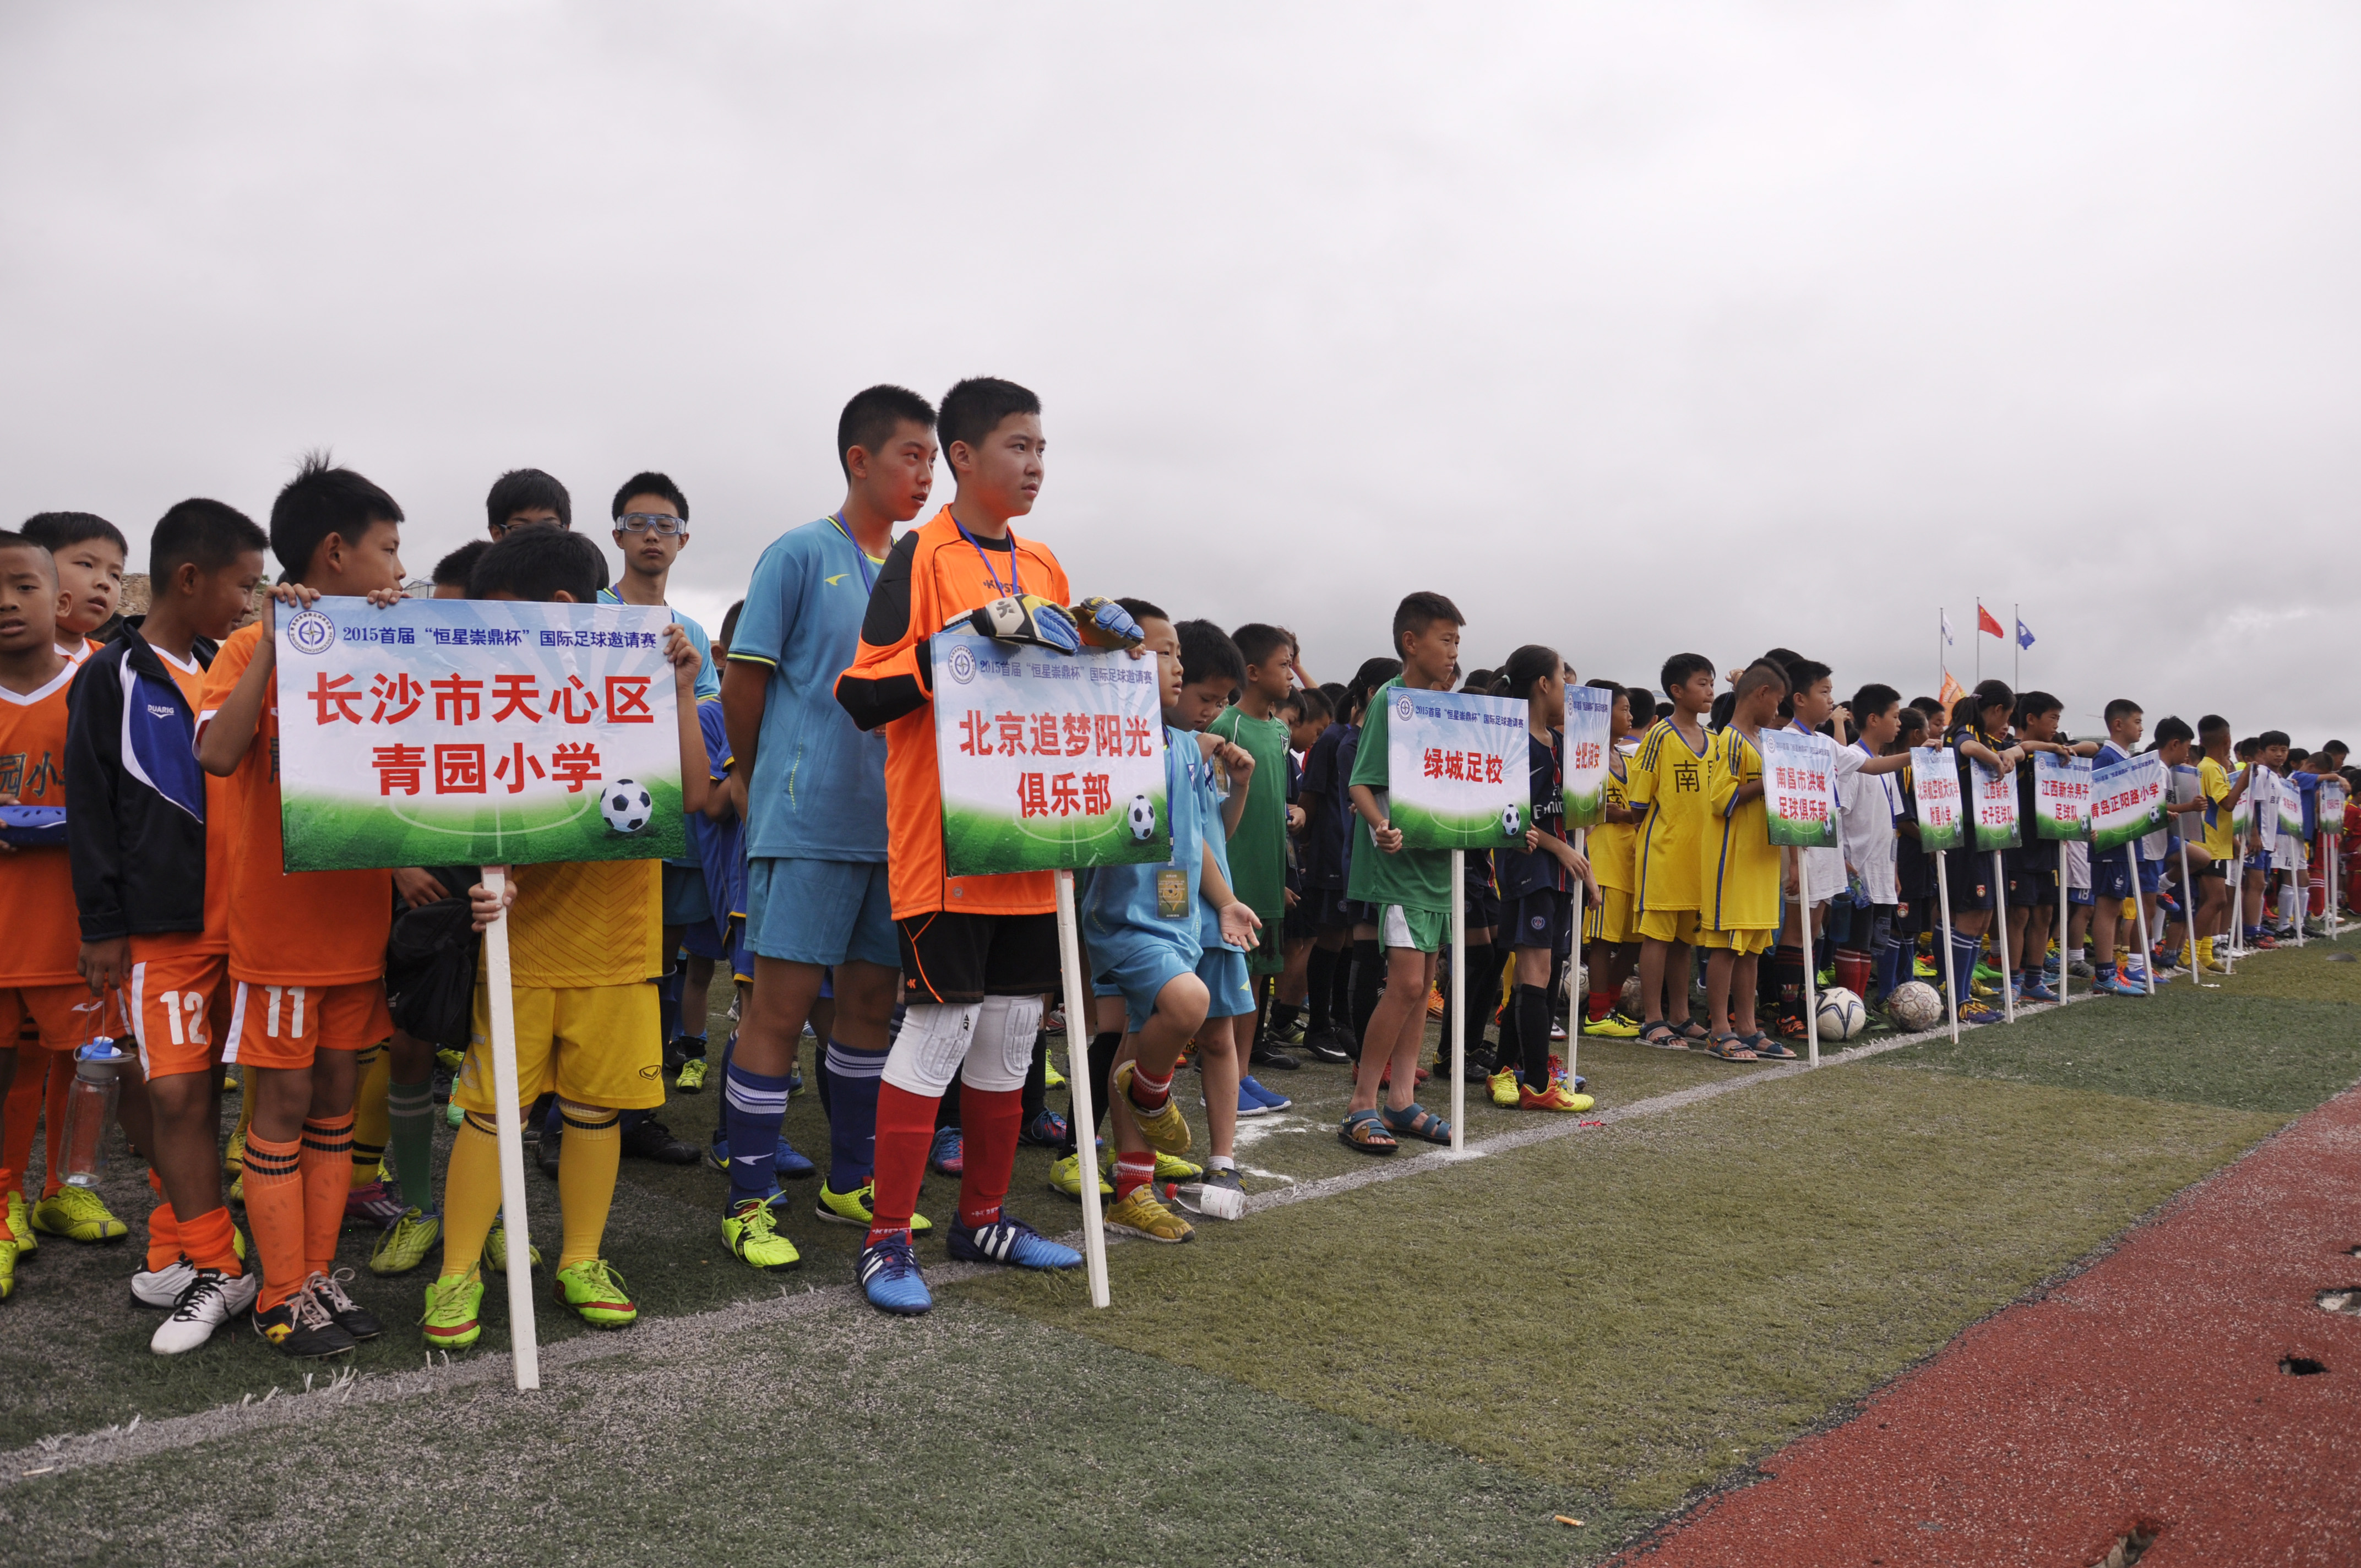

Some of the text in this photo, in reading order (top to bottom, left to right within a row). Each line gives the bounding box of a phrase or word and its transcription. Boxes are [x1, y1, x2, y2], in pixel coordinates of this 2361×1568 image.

[148, 705, 174, 714] DUARIG
[307, 672, 654, 726] 长沙市天心区
[959, 710, 1152, 758] 北京追梦阳光
[0, 752, 66, 798] 园小
[372, 742, 602, 796] 青园小学
[1424, 747, 1503, 784] 绿城足校
[1776, 766, 1826, 793] 南昌市洪城
[1017, 771, 1112, 818] 俱乐部
[1983, 781, 2009, 799] 江西新余
[2042, 780, 2089, 800] 江西新余男子
[2091, 782, 2159, 819] 青岛正阳路小学
[1779, 796, 1828, 822] 足球俱乐部
[1982, 805, 2014, 825] 女子足球队
[2055, 803, 2079, 821] 足球队
[160, 990, 206, 1046] 12
[265, 986, 305, 1038] 11
